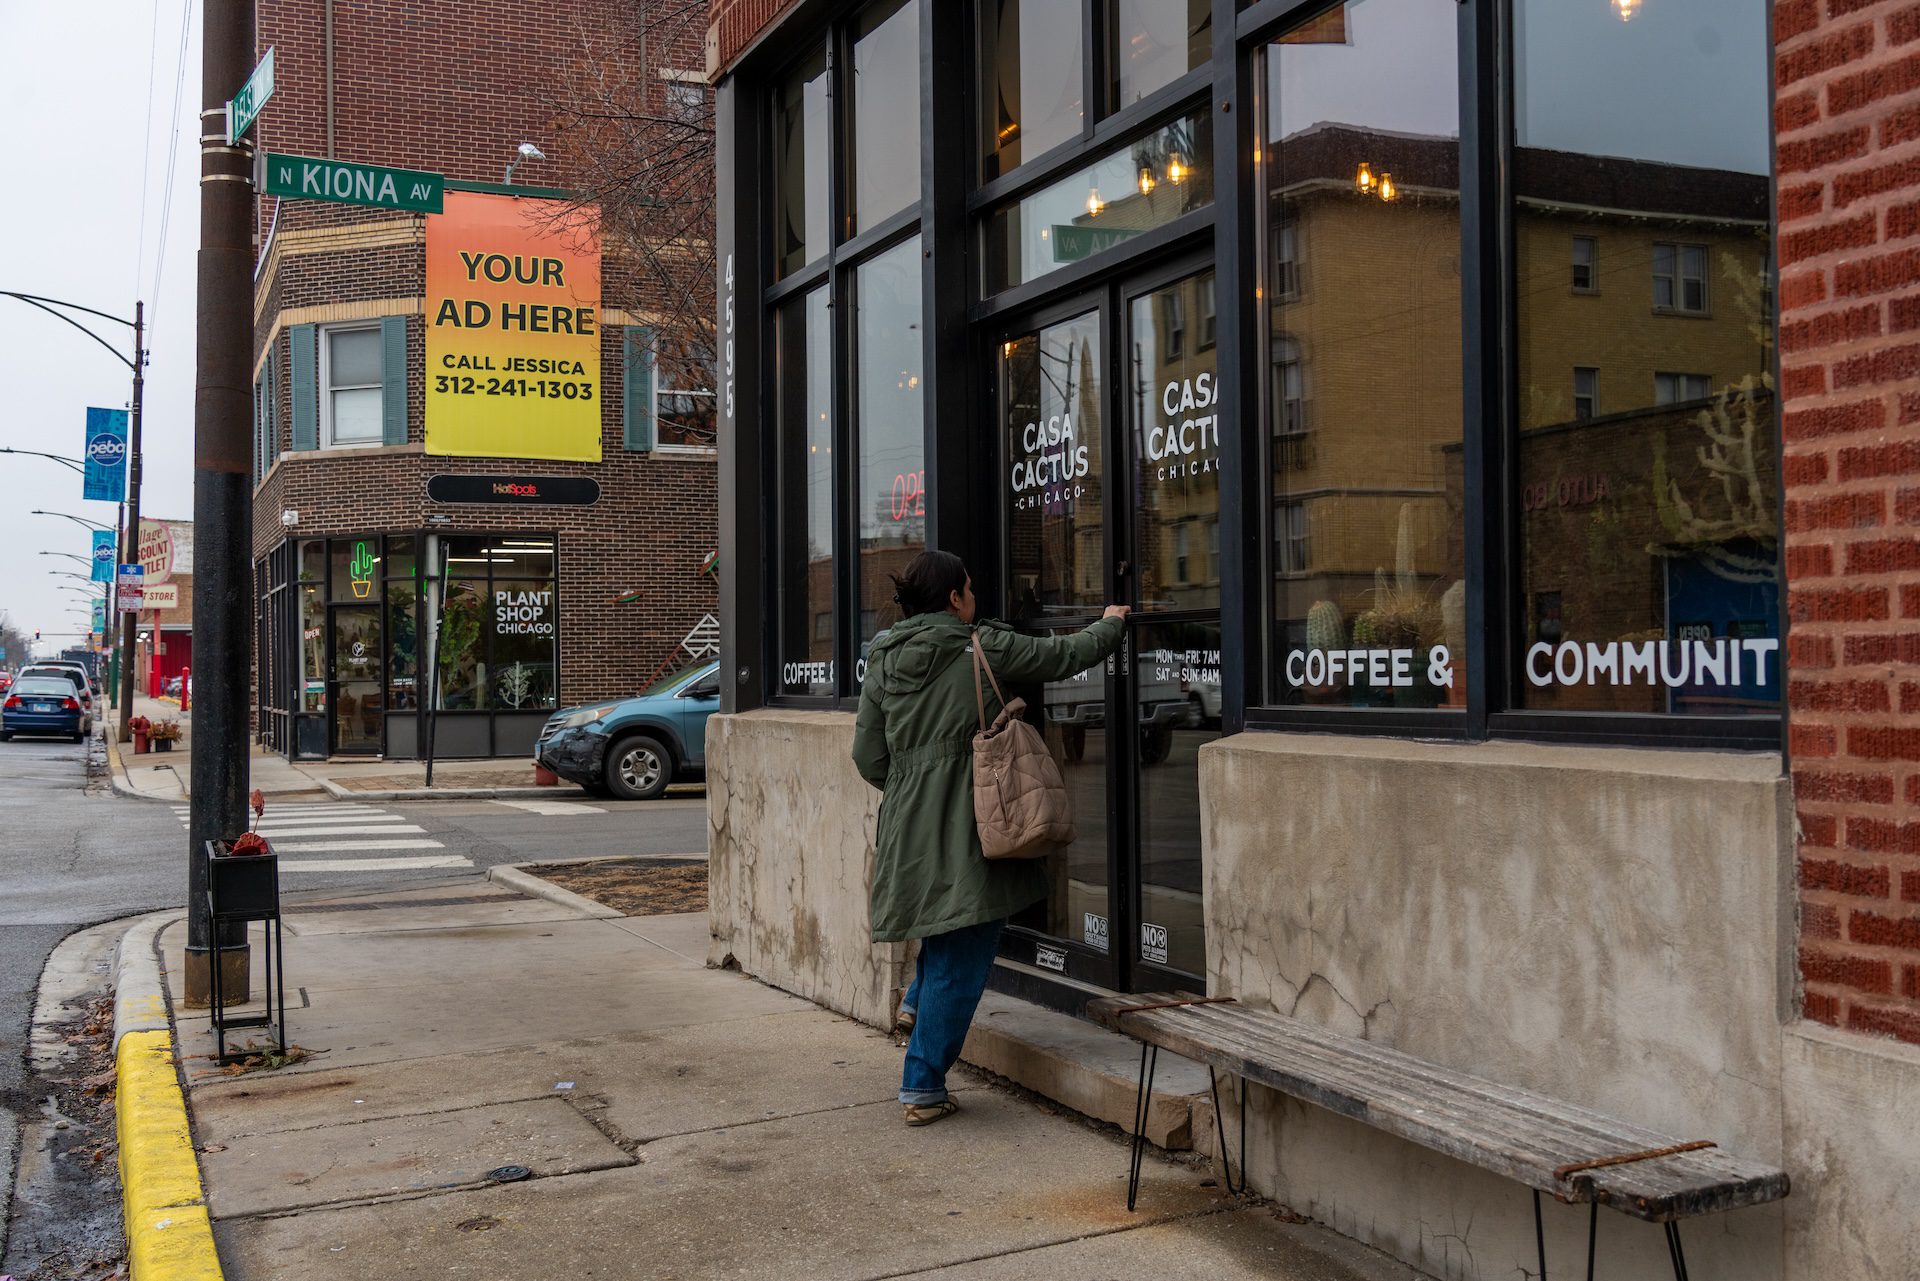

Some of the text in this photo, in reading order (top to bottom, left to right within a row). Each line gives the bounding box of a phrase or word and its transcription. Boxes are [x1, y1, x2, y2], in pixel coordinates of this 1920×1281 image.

[280, 163, 431, 204] N KIONA AV
[459, 251, 565, 288] YOUR
[435, 298, 595, 336] AD HERE
[725, 254, 734, 418] 4595
[442, 354, 585, 376] CALL JESSICA
[435, 375, 593, 401] 312-241-1303
[1023, 413, 1074, 454] CASA
[1011, 445, 1089, 492] CACTUS
[892, 470, 925, 521] OPE
[139, 527, 162, 544] llage
[138, 540, 168, 560] COUNT
[144, 557, 166, 575] TLET
[149, 592, 175, 601] STORE
[496, 591, 551, 606] PLANT
[496, 606, 544, 622] SHOP
[304, 628, 320, 640] OPEN
[496, 623, 553, 634] CHICAGO
[1156, 650, 1173, 663] MON
[1203, 651, 1220, 665] 7AM
[1286, 644, 1453, 688] COFFEE &
[1526, 638, 1779, 687] COMMUNIT
[784, 662, 826, 684] COFFEE
[1156, 667, 1171, 681] SAT
[1202, 669, 1220, 683] 8AM
[1085, 914, 1100, 934] NO
[1143, 926, 1157, 947] NO
